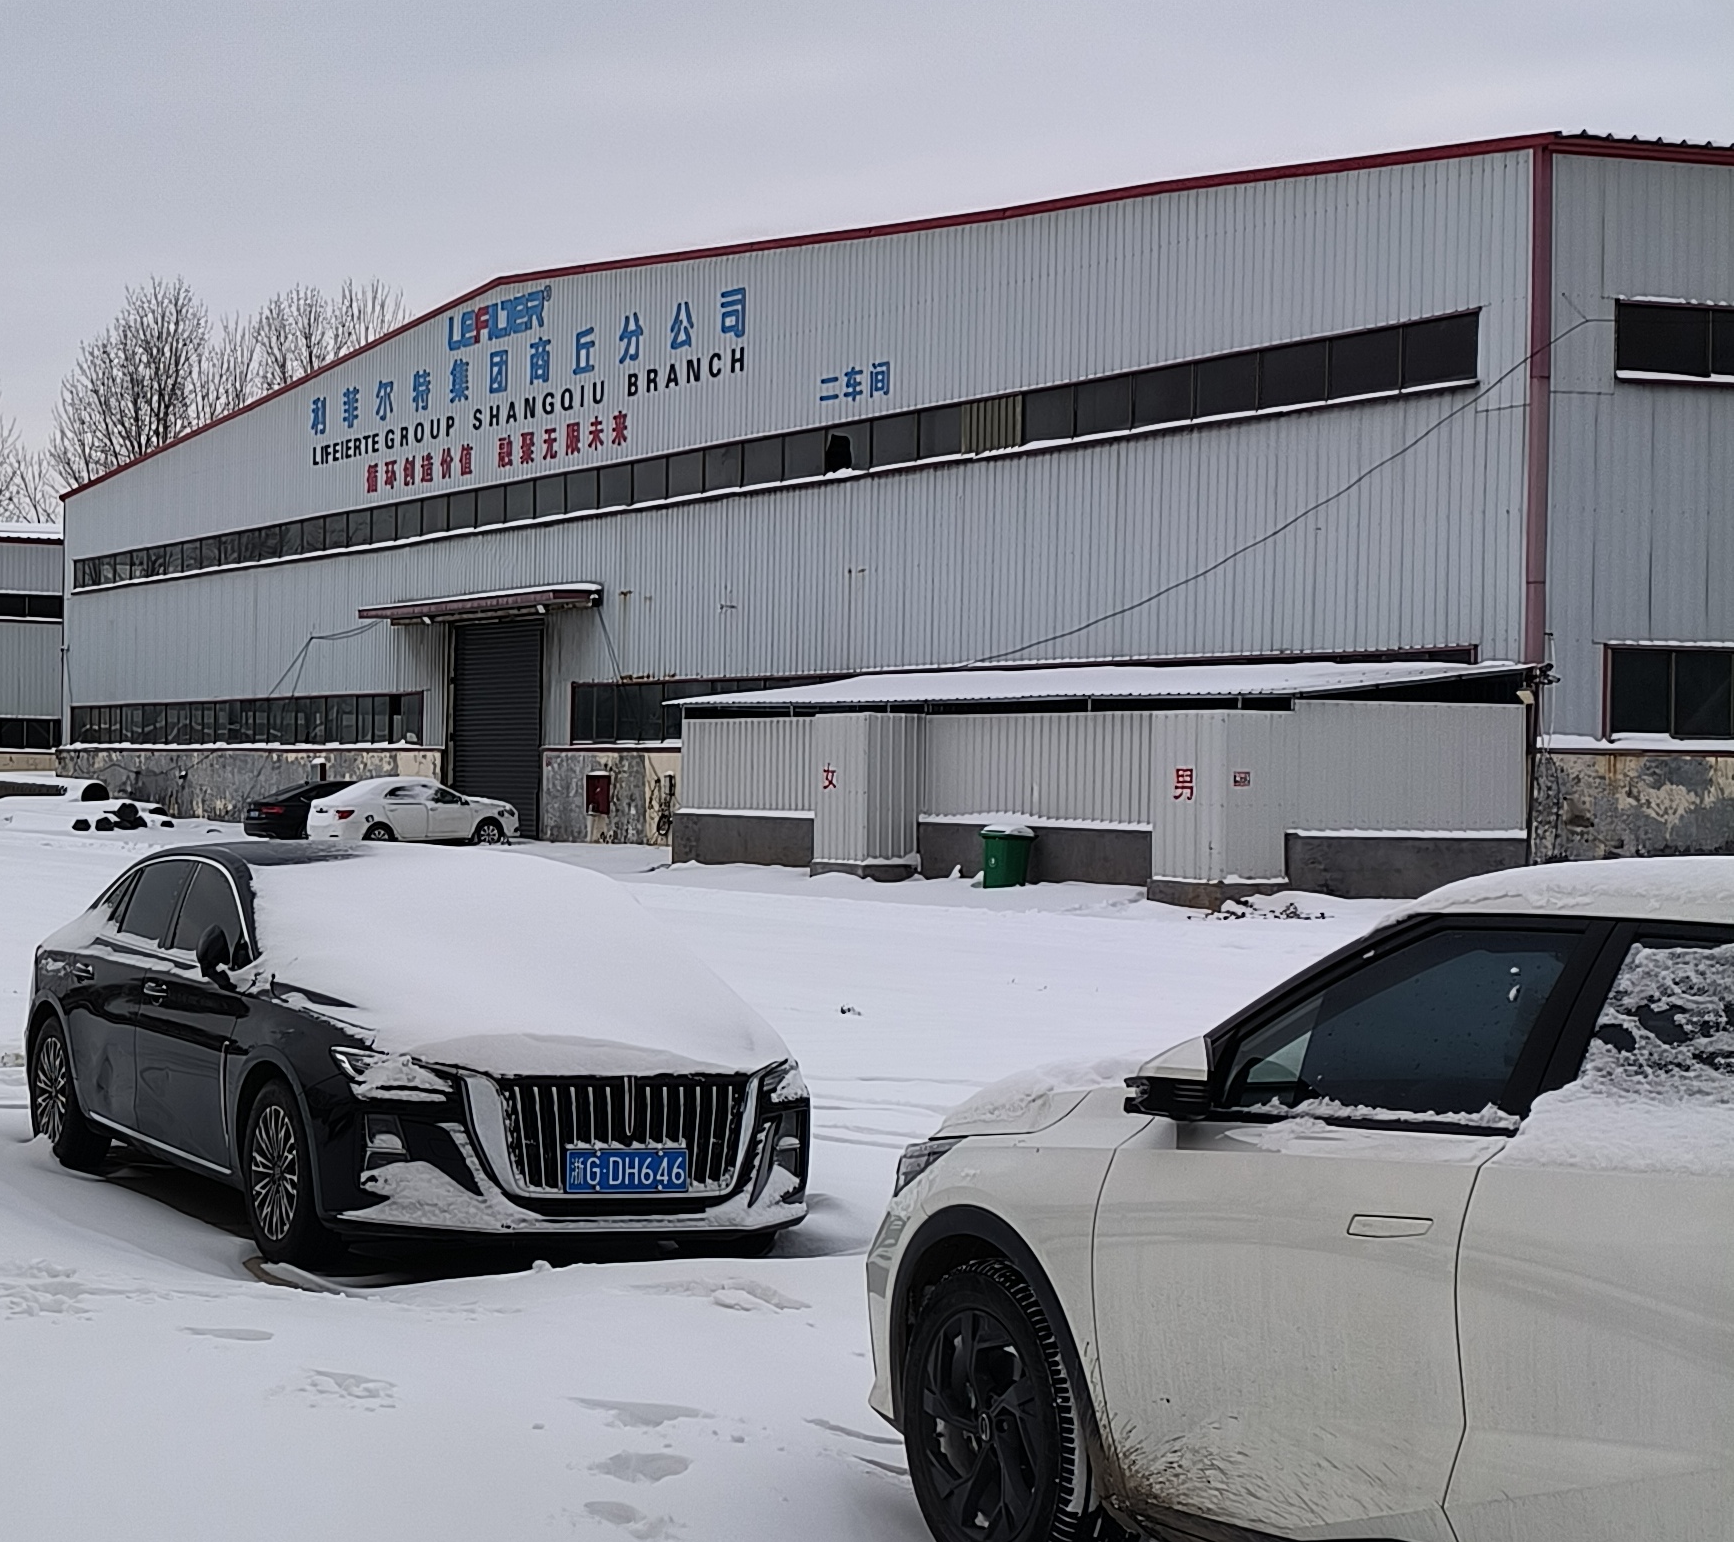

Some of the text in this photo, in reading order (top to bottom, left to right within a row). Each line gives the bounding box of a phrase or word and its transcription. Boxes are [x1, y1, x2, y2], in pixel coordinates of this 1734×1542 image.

[311, 287, 746, 435] 利菲尔特集团商丘分公司
[472, 380, 605, 430] SHANGQIU
[627, 346, 745, 397] BRANCH
[819, 360, 890, 402] 二车间
[366, 410, 628, 493] 循环创造价值 融聚无限未来
[823, 762, 837, 790] 女
[1173, 768, 1194, 801] 男
